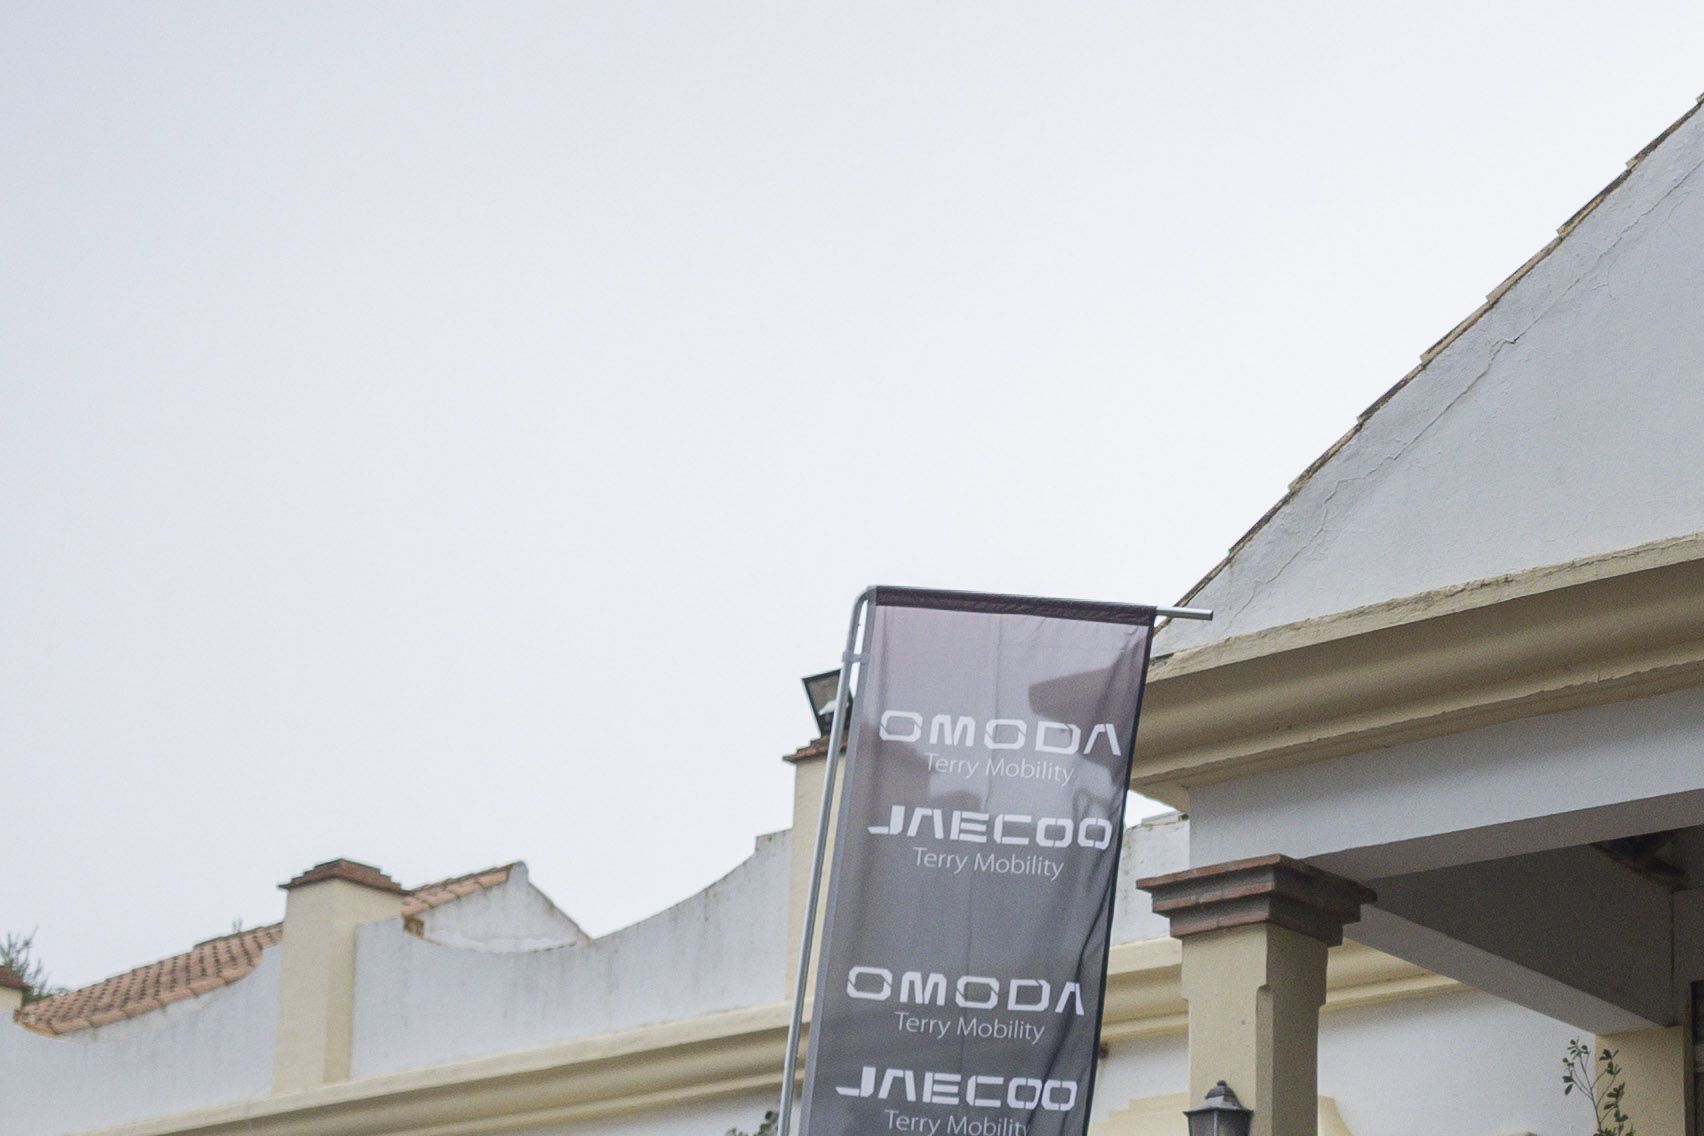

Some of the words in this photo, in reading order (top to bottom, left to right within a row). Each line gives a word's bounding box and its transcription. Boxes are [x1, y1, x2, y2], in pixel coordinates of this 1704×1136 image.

[879, 710, 1121, 756] OMODA
[922, 752, 978, 778] Terry
[985, 758, 1073, 786] Mobility
[868, 805, 1112, 850] JAECOO
[913, 847, 968, 874] Terry
[974, 853, 1064, 880] Mobility
[847, 966, 1085, 1016] OMODA
[895, 1012, 950, 1039] Terry
[957, 1017, 1044, 1044] Mobility
[835, 1066, 1078, 1111] JAECOO
